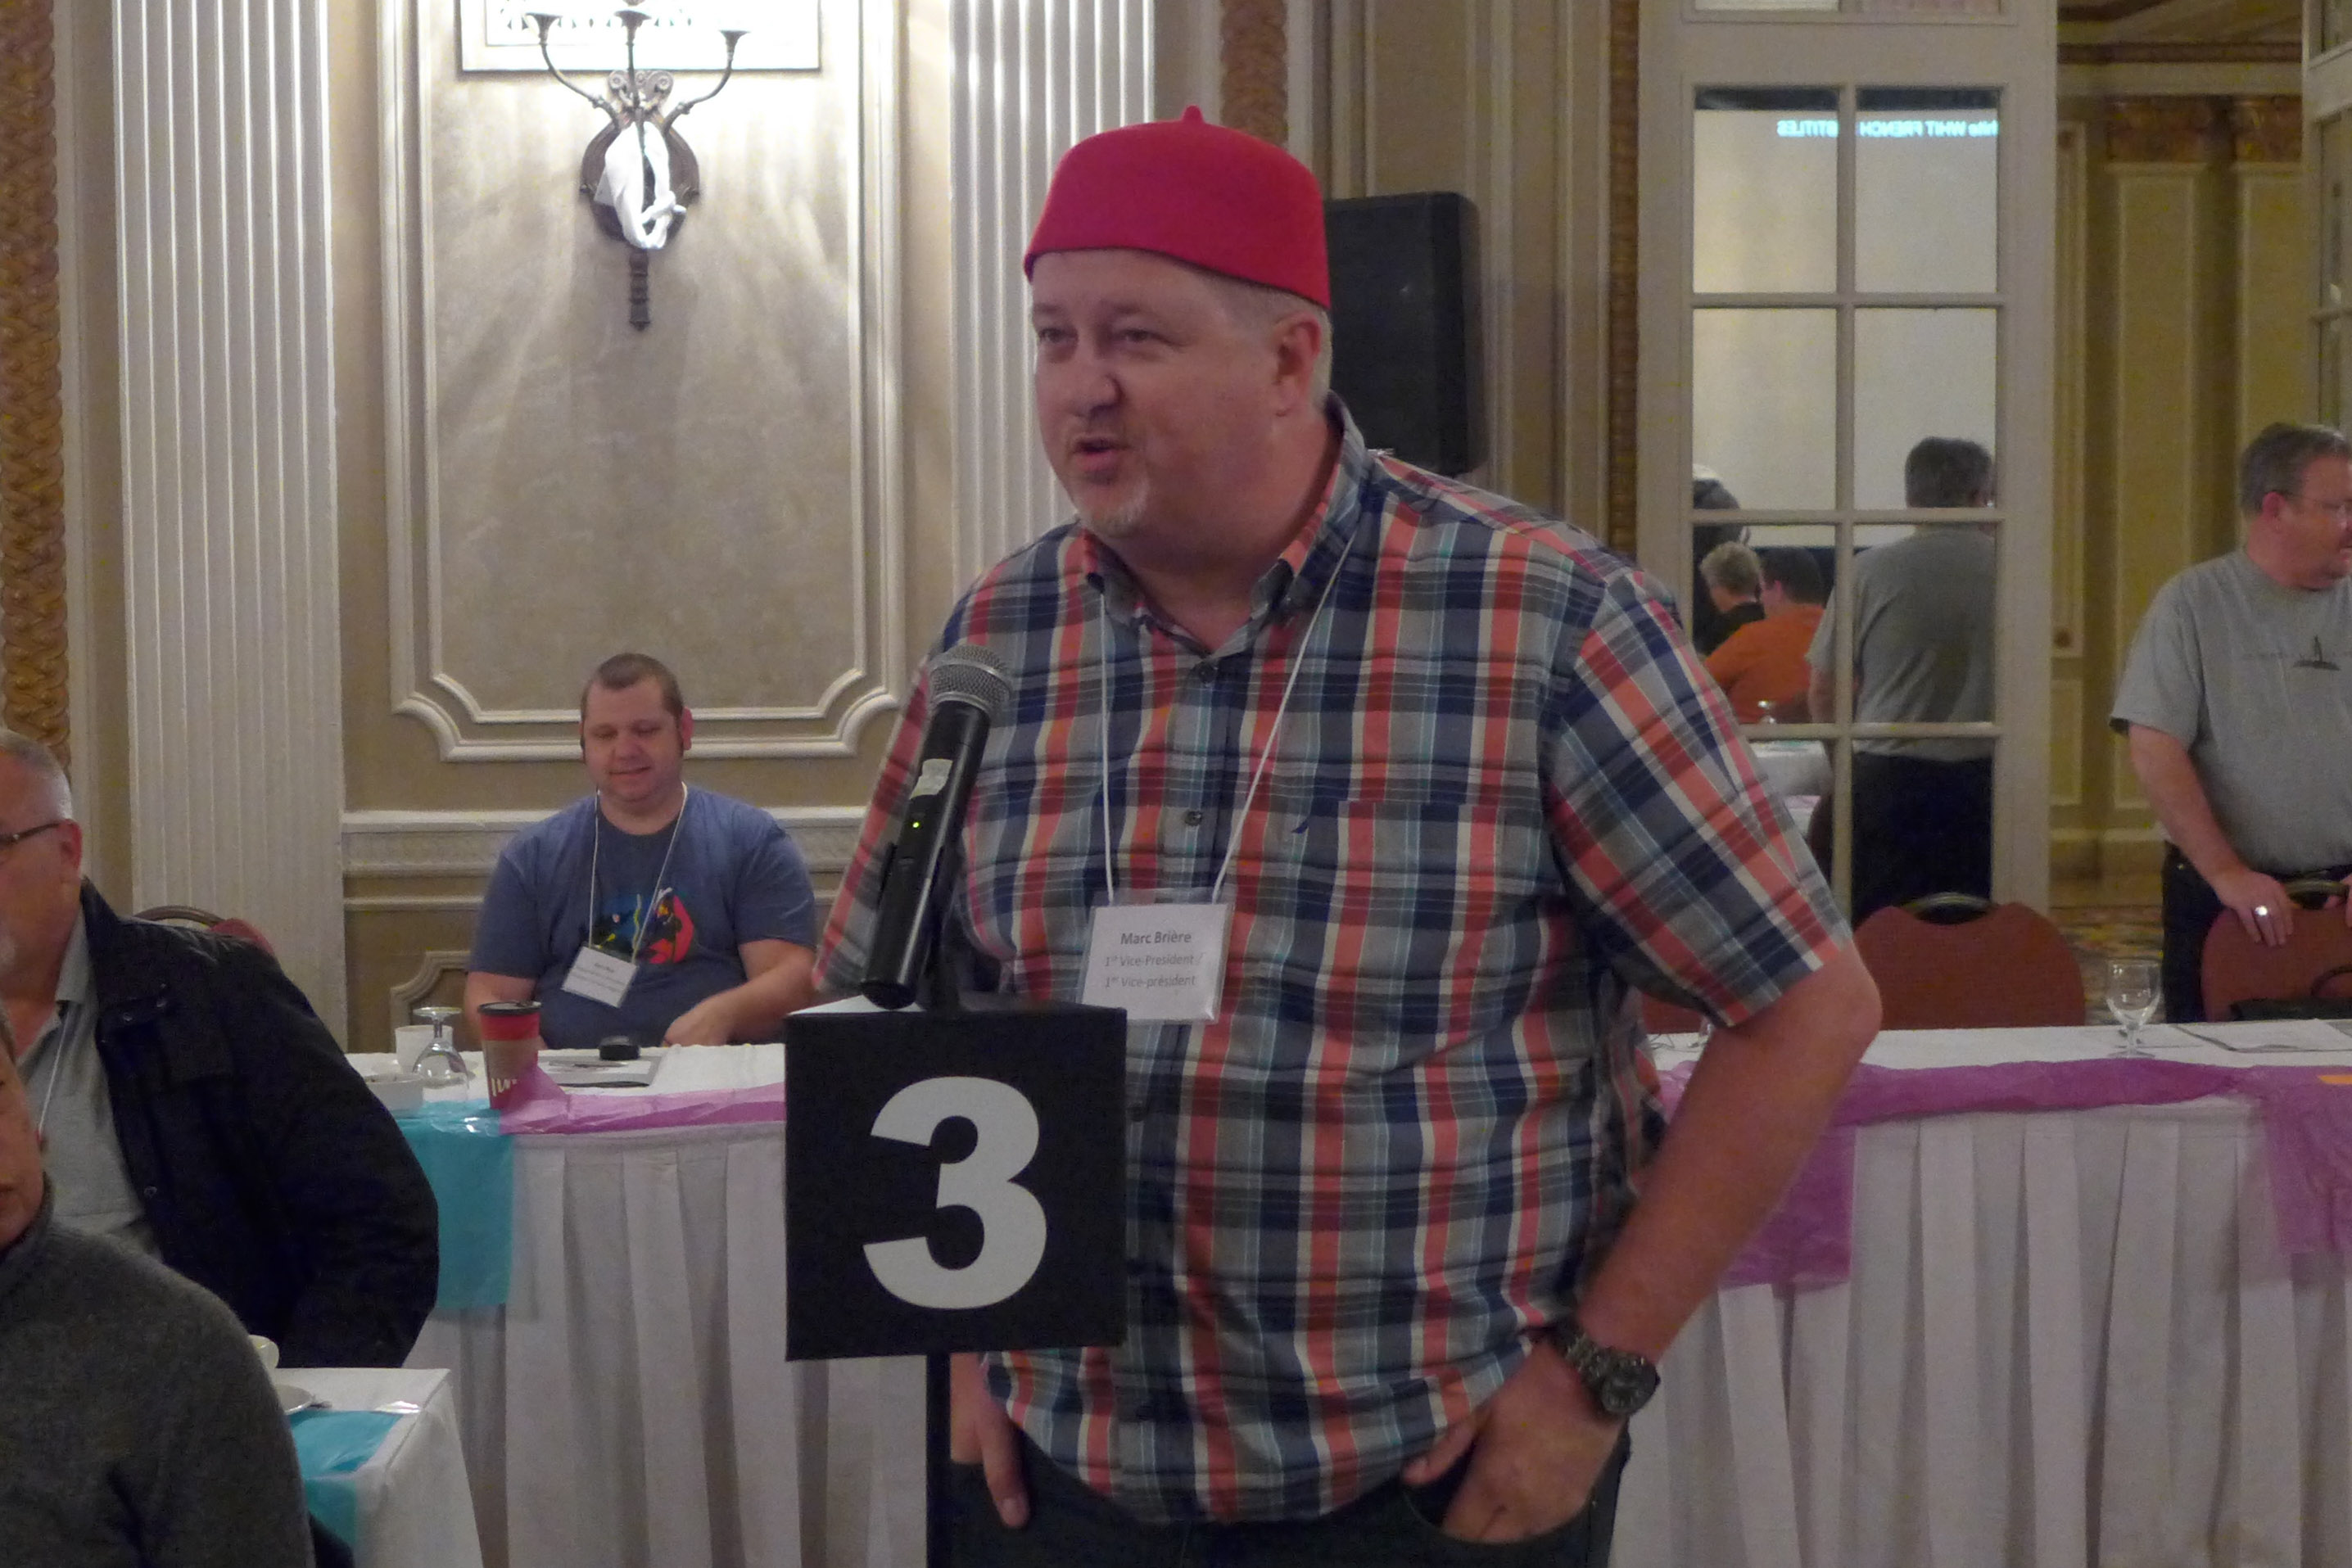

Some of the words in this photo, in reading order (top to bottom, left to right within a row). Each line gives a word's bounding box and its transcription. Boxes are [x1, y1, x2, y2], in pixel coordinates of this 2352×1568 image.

[1119, 932, 1152, 945] Marc
[1154, 930, 1192, 944] Brière
[1119, 953, 1195, 967] Vice-President
[862, 1075, 1047, 1310] 3
